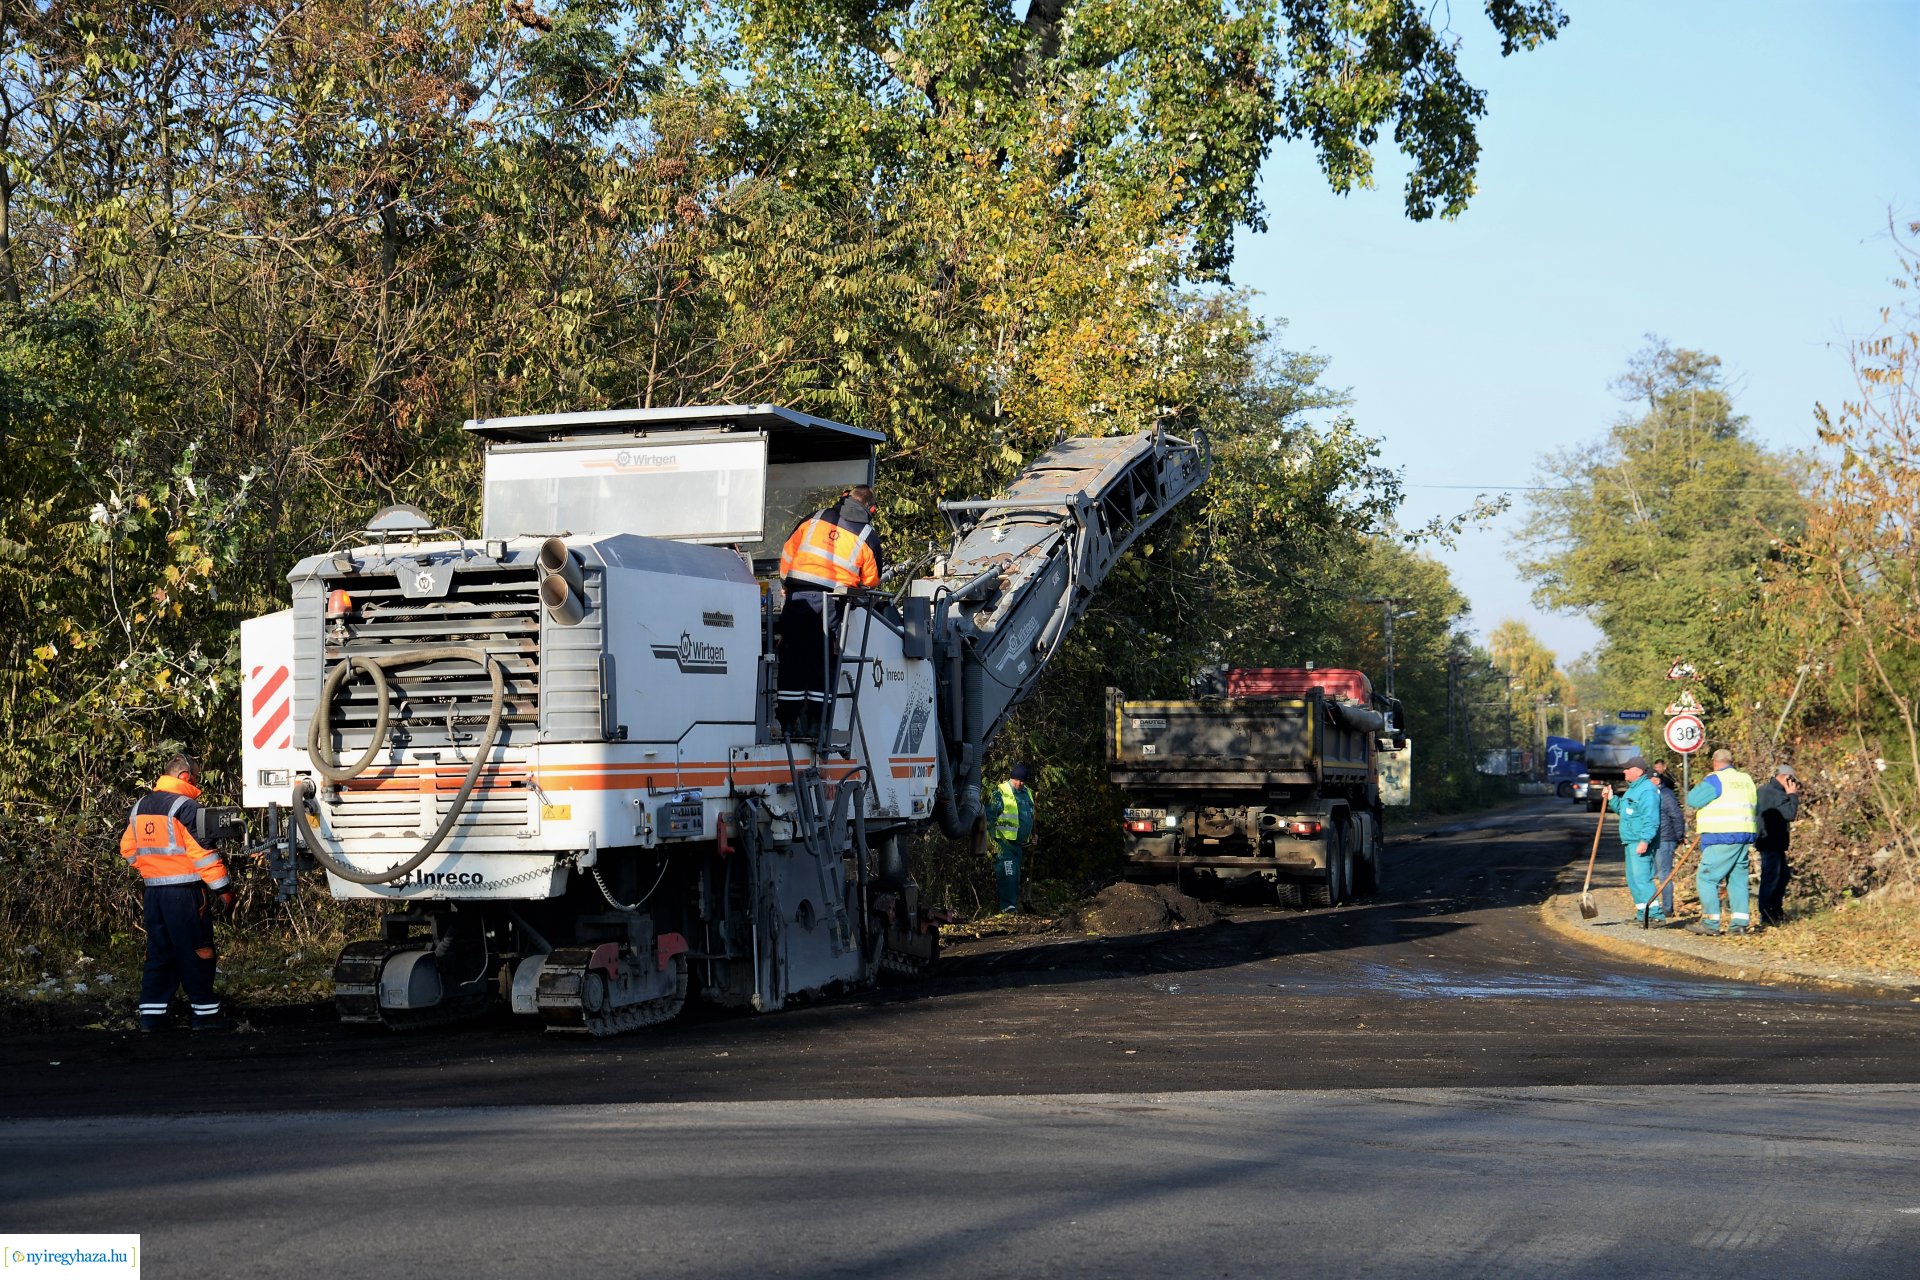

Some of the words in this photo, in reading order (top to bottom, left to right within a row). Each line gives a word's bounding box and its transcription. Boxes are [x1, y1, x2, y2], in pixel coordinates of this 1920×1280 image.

[633, 454, 676, 466] Wirtgen
[693, 641, 725, 664] Wirtgen
[886, 668, 905, 681] Inreco
[1676, 727, 1694, 741] 30
[416, 869, 484, 885] Inreco
